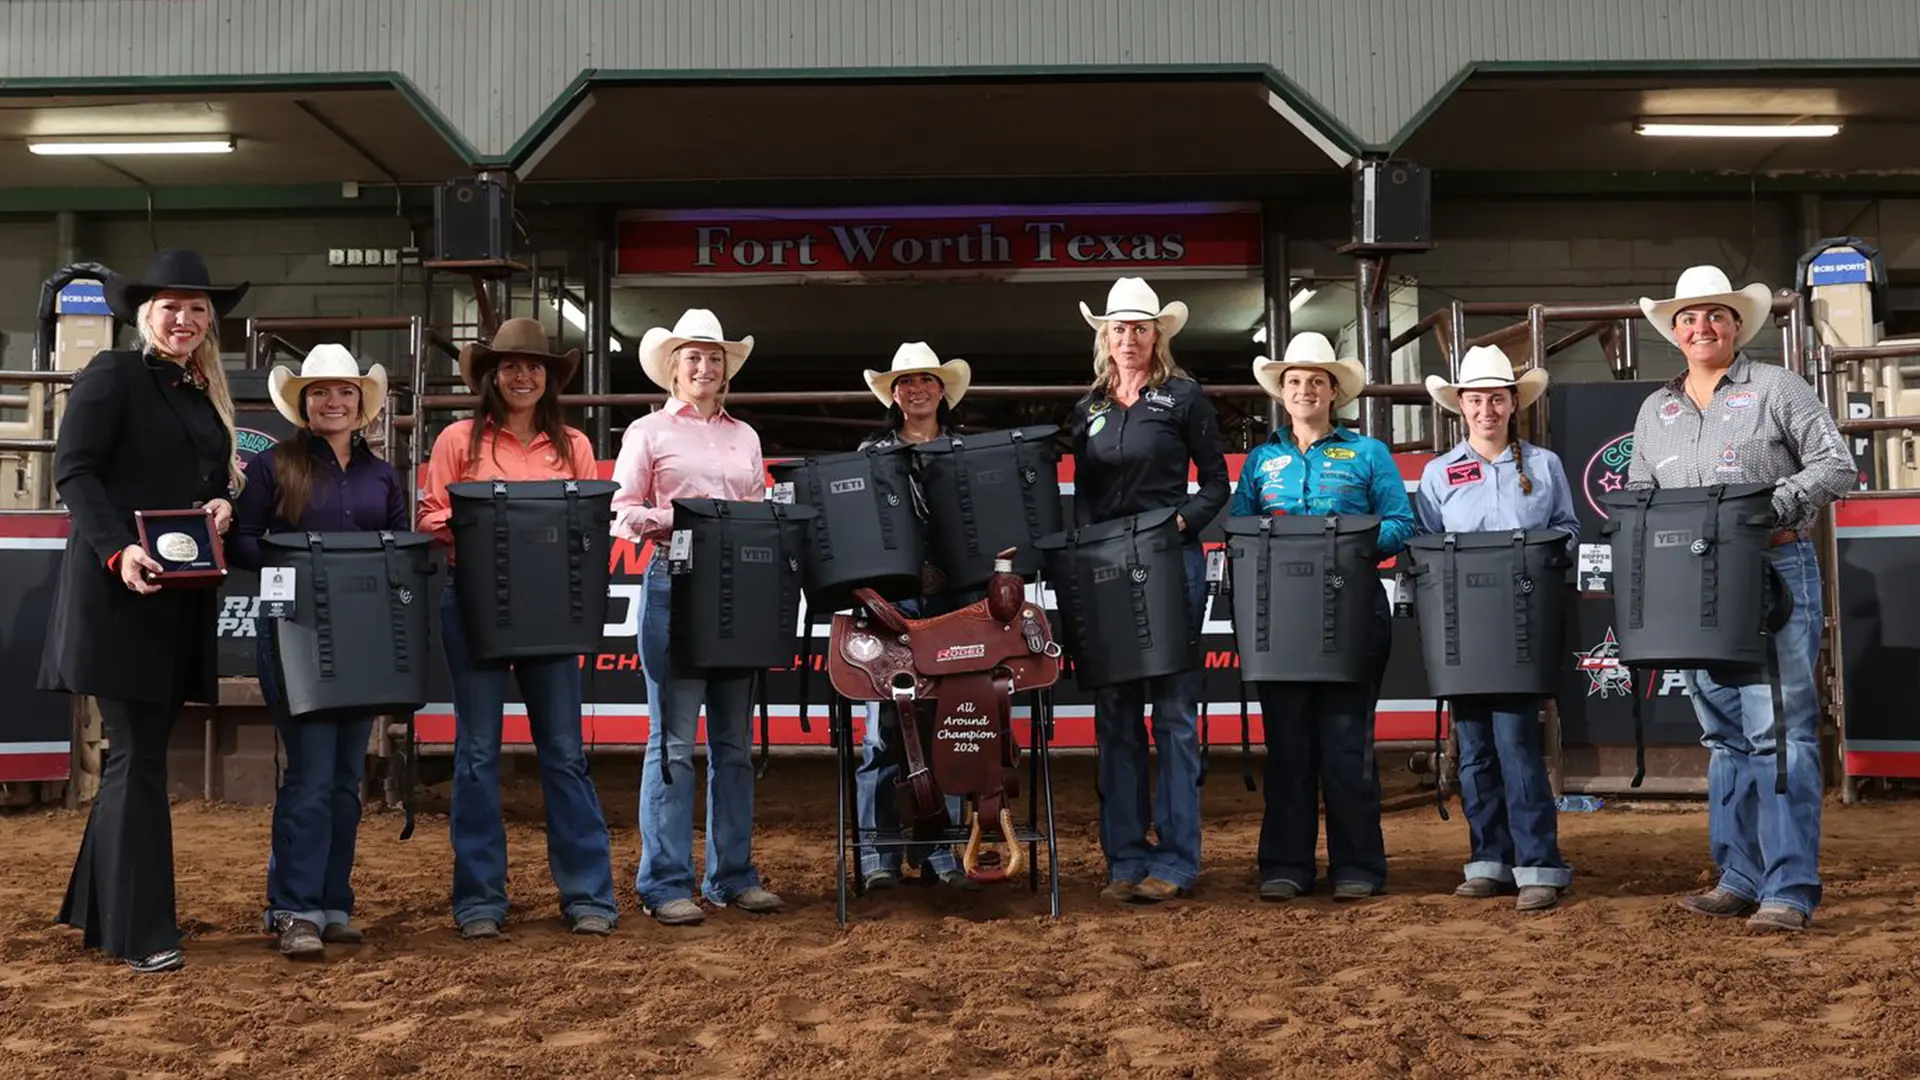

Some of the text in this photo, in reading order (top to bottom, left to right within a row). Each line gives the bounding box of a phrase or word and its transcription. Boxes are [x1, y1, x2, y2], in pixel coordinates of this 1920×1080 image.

[693, 221, 1186, 267] Fort Worth Texas
[1836, 263, 1866, 271] SPORTS
[832, 480, 863, 491] YETI
[743, 549, 770, 560] YETI
[956, 702, 976, 713] All
[943, 715, 990, 726] Around
[937, 729, 997, 743] Champion
[953, 743, 980, 753] 2024
